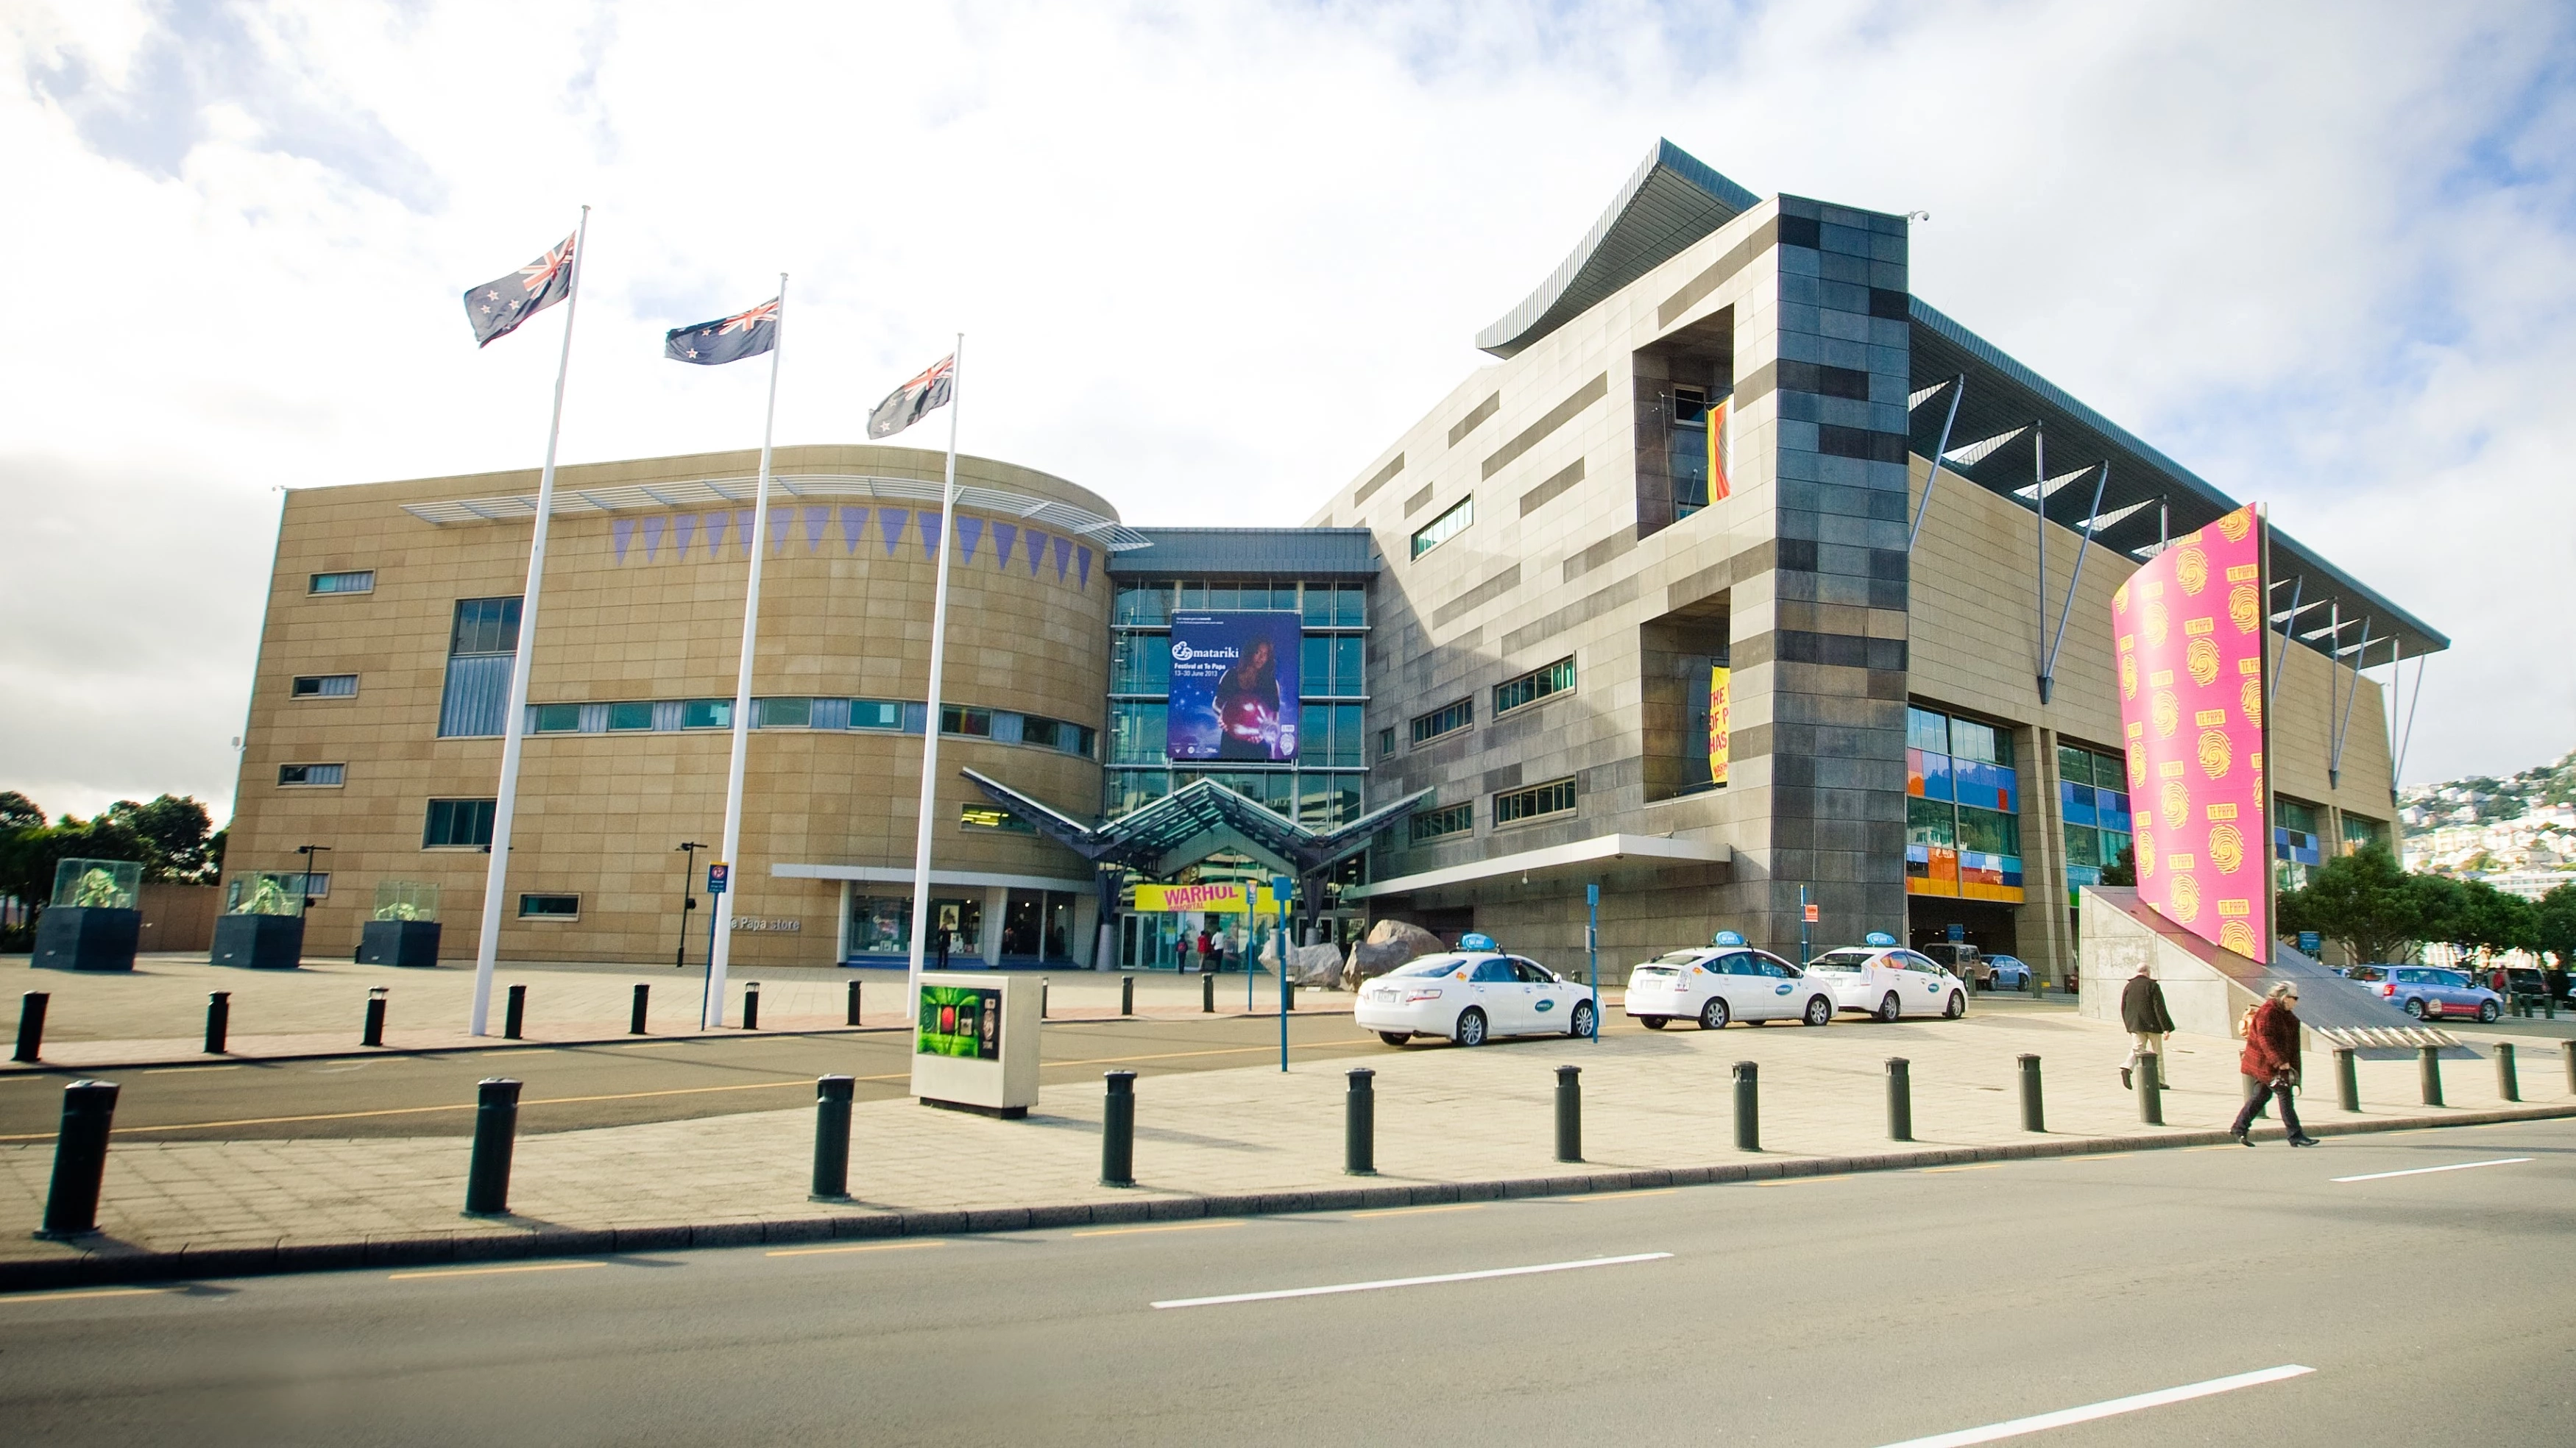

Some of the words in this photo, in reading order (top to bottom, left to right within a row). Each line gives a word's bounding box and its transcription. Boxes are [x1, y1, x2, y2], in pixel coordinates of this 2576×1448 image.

[2229, 568, 2237, 580] TE
[2238, 566, 2255, 578] PAPA
[2187, 622, 2194, 633] TE
[2195, 619, 2211, 631] PAPA
[1193, 647, 1239, 658] matariki
[2241, 660, 2248, 672] TE
[1710, 687, 1725, 708] THE
[1710, 711, 1719, 731] OF
[2198, 713, 2205, 724] TE
[2207, 711, 2223, 723] PAPA
[1710, 731, 1727, 755] HAS
[2209, 806, 2217, 817] TE
[2218, 805, 2234, 817] PAPA
[2220, 901, 2228, 913] TE
[2229, 901, 2246, 913] PAPA
[740, 917, 766, 931] Papa
[771, 919, 800, 930] store
